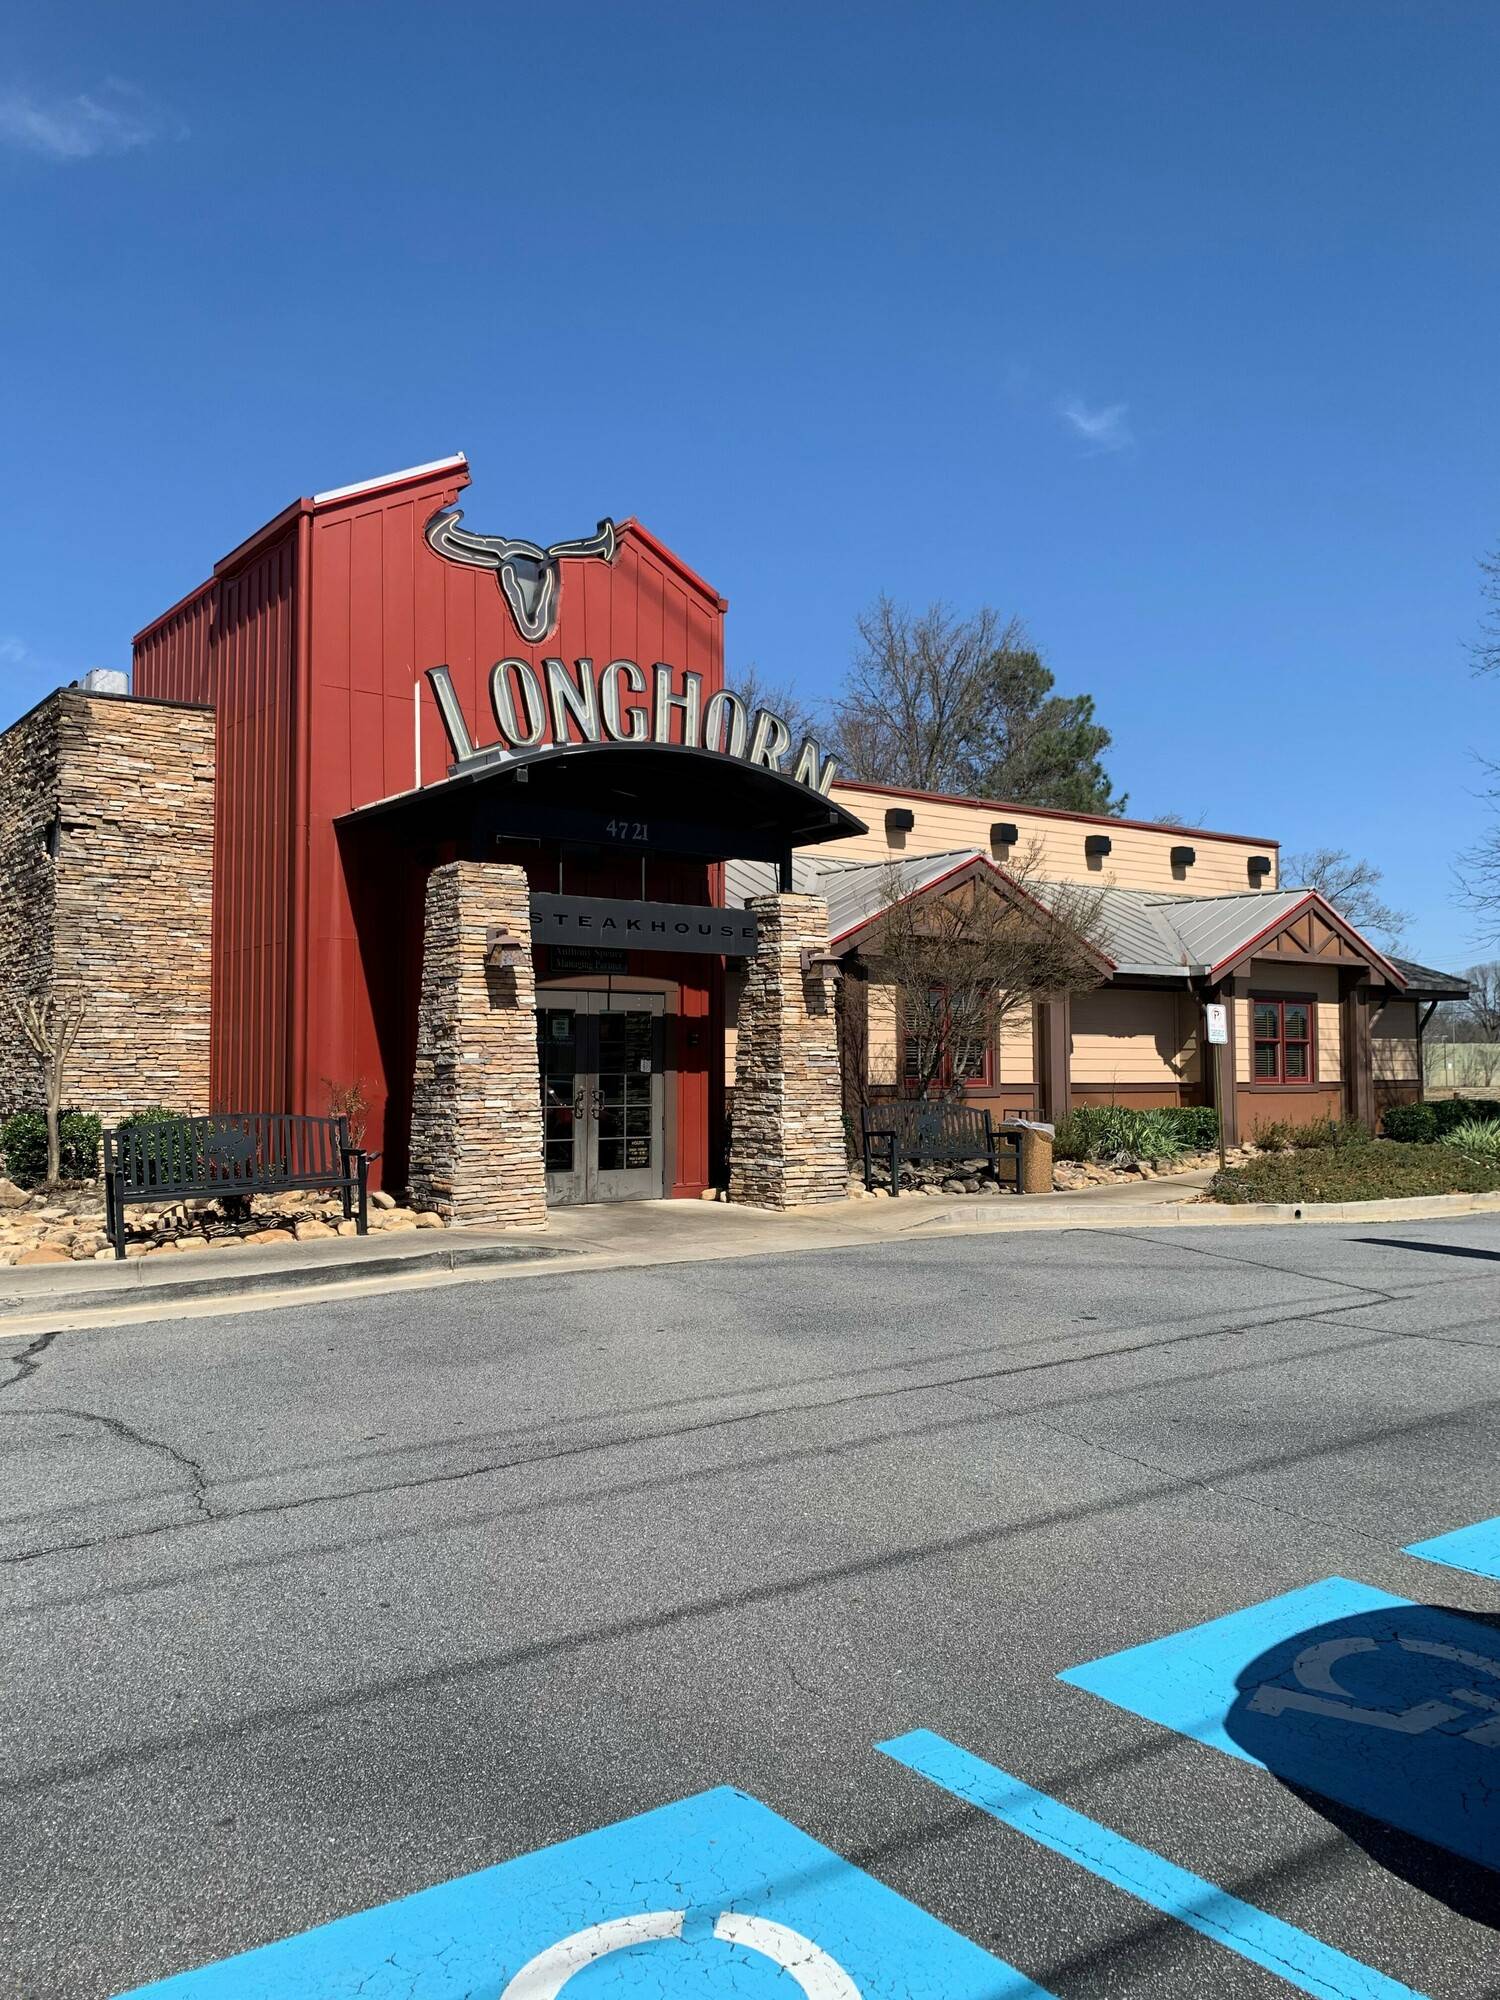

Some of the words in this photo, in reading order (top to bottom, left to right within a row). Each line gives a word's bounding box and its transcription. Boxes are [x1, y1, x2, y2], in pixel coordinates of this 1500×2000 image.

[425, 657, 840, 798] LONGHORN
[606, 819, 649, 841] 4721
[529, 912, 754, 938] STEAKHOUSE
